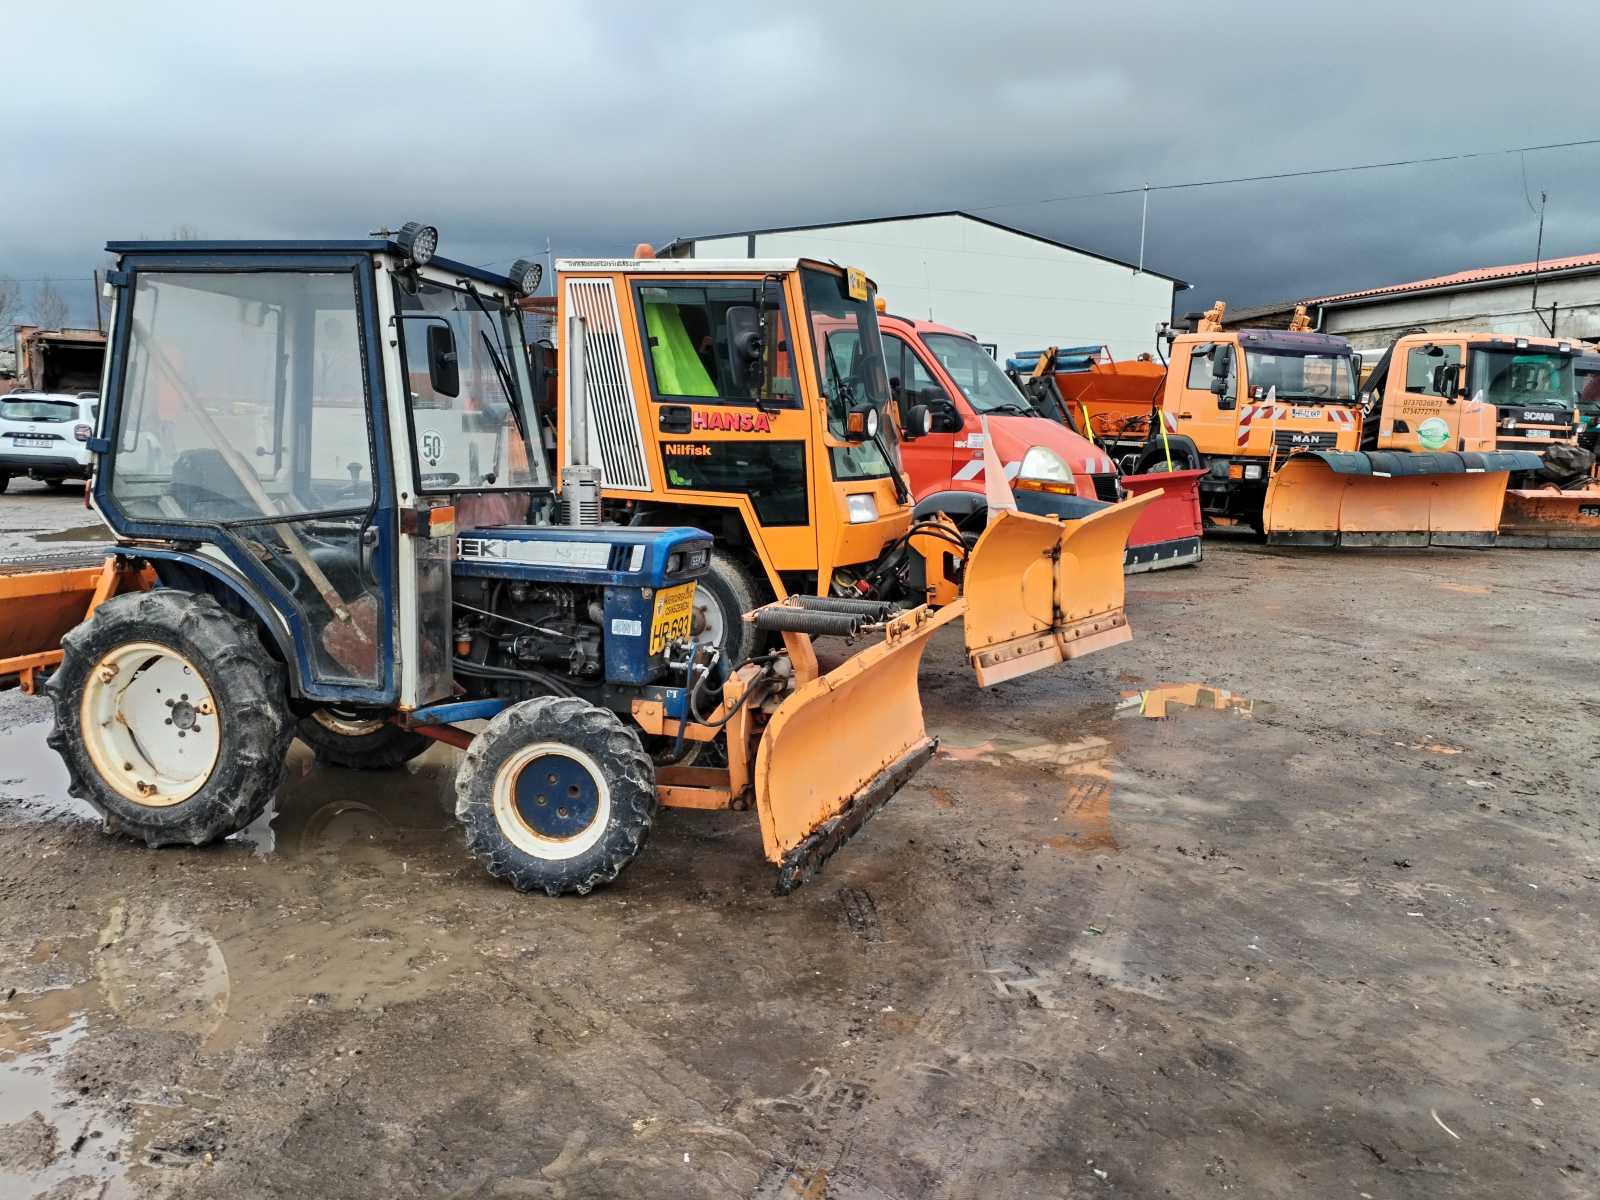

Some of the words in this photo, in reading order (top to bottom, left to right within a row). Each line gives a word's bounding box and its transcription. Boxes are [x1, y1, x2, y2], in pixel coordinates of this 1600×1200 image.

[693, 411, 771, 433] HANSA
[1523, 411, 1555, 421] SCANIA
[1292, 434, 1320, 443] MAN
[423, 435, 441, 459] 50
[665, 444, 712, 456] Nilfisk
